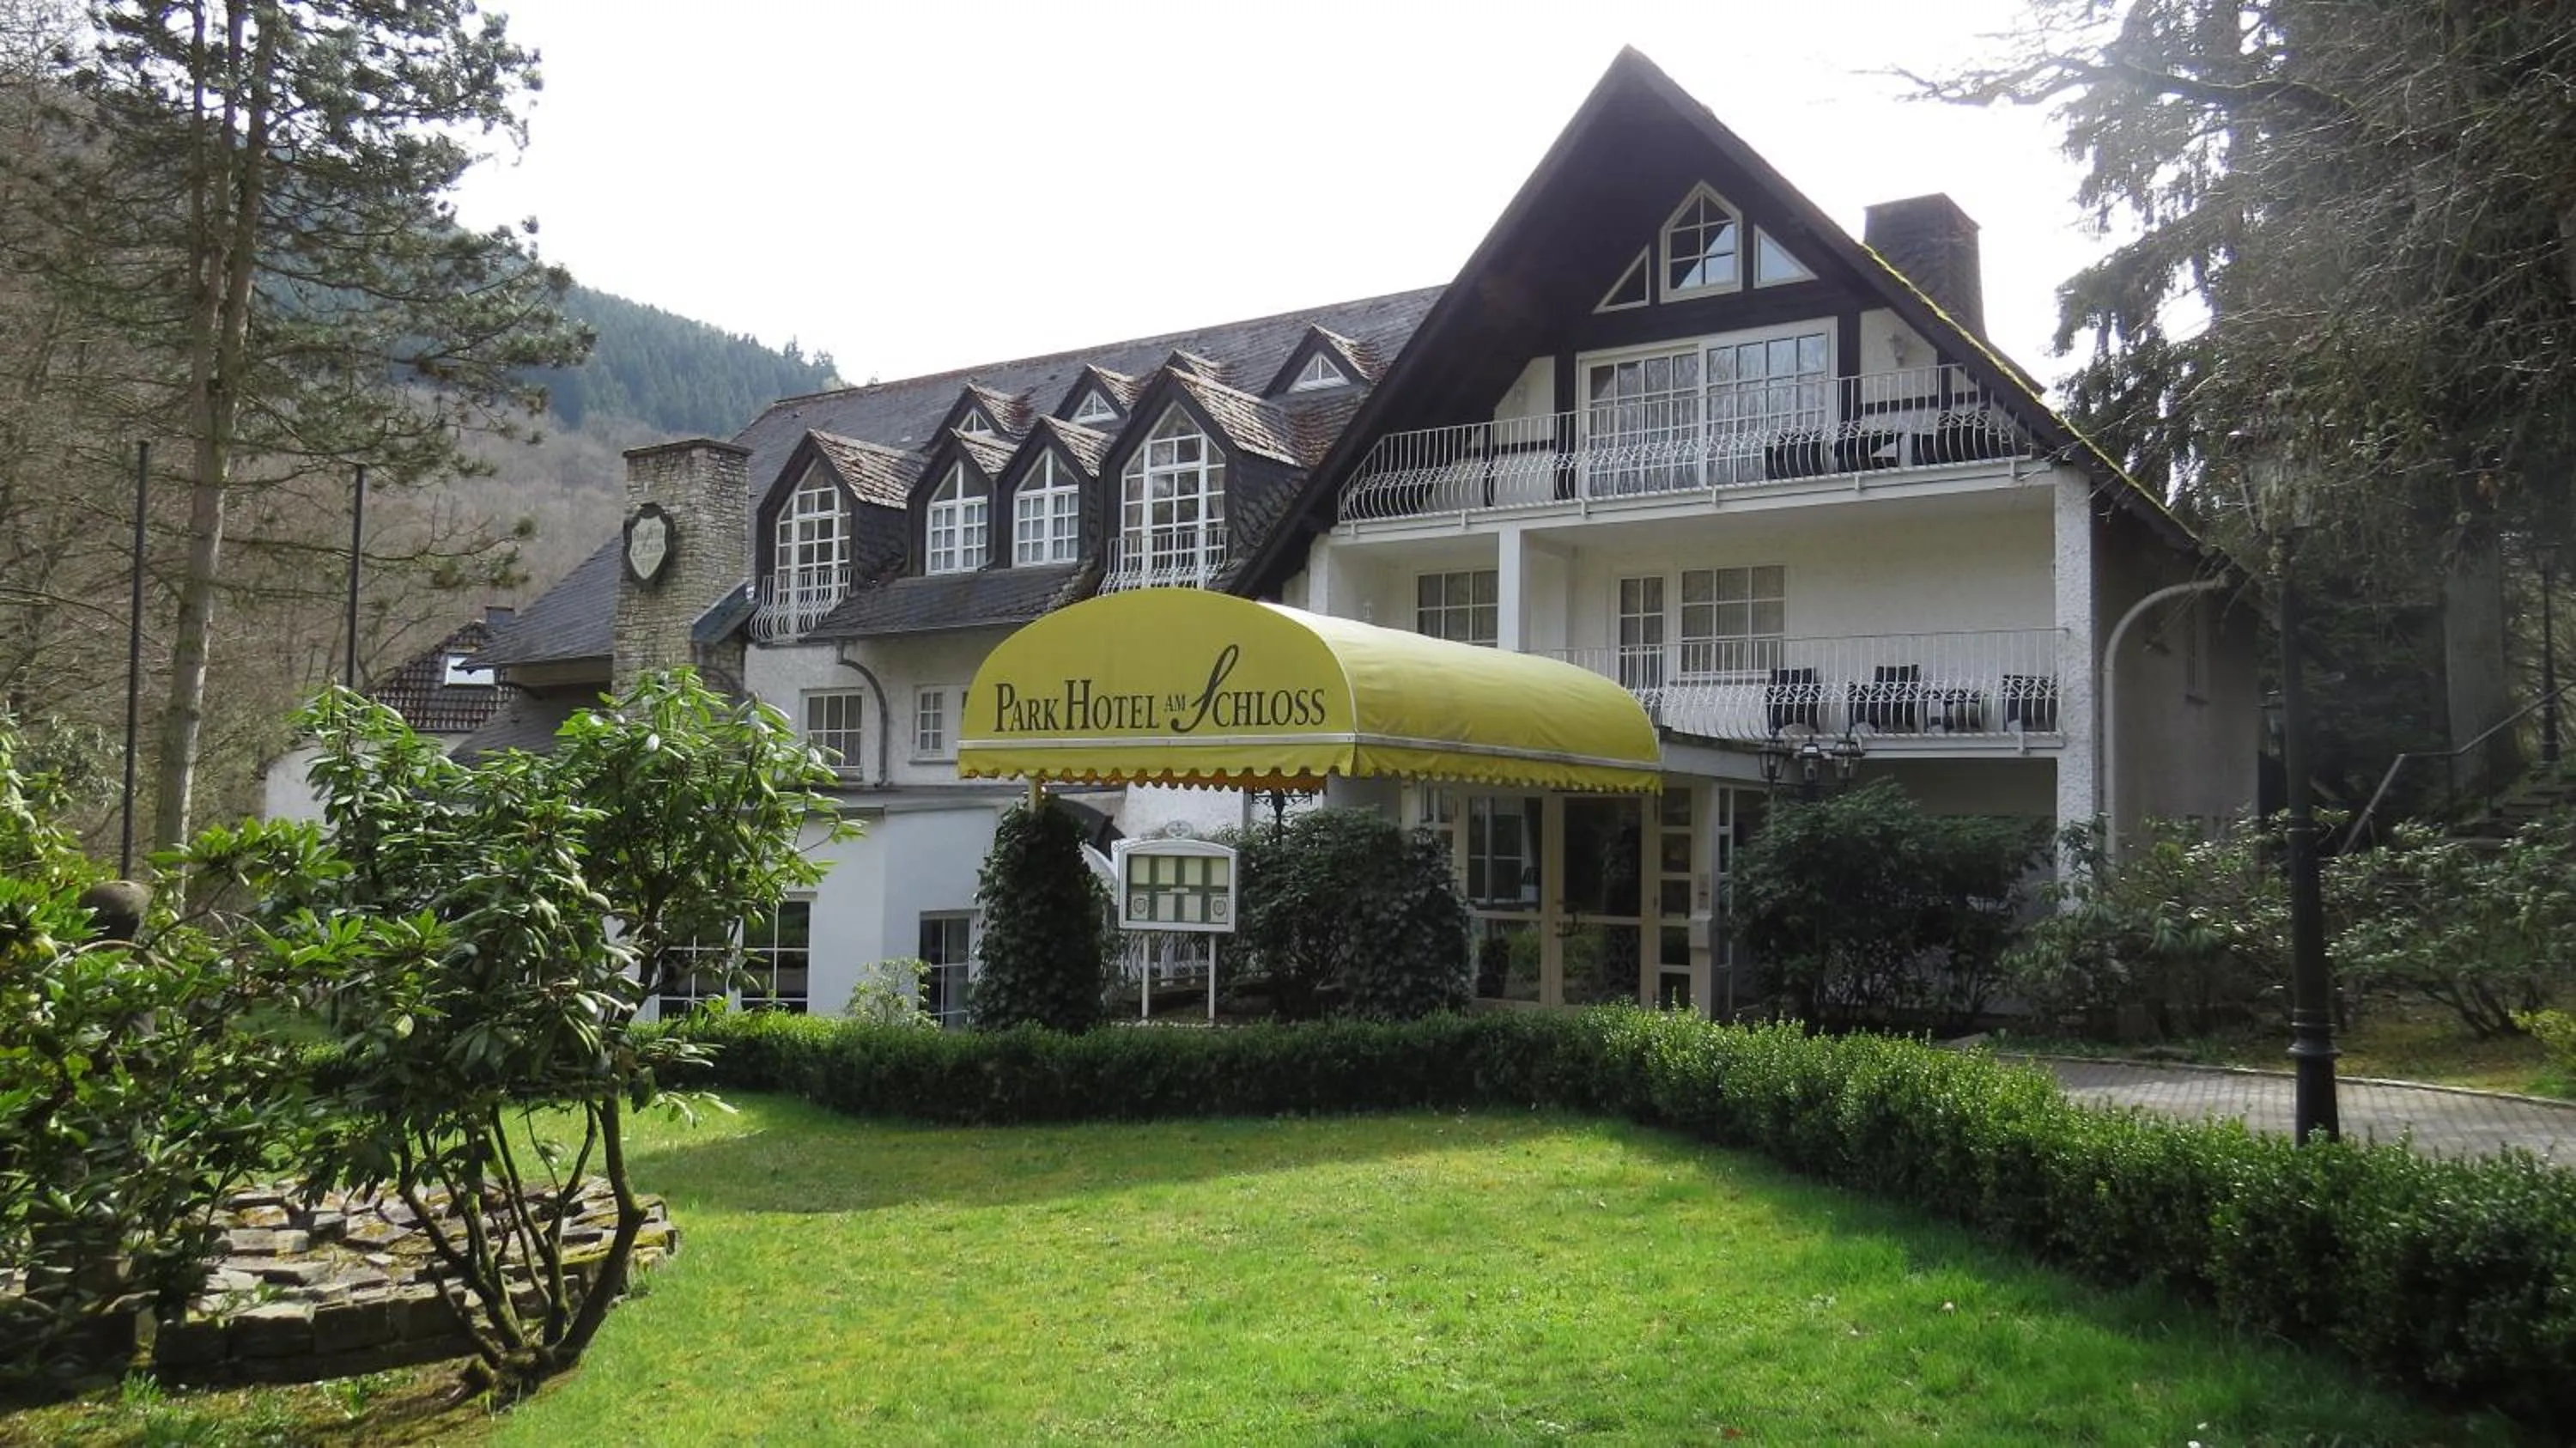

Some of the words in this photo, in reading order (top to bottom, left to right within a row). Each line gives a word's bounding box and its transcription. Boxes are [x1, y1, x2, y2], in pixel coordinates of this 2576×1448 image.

[993, 683, 1060, 733] PARK
[1064, 678, 1159, 731] HOTEL
[1164, 694, 1187, 713] AM
[1170, 644, 1326, 733] SCHLOSS
